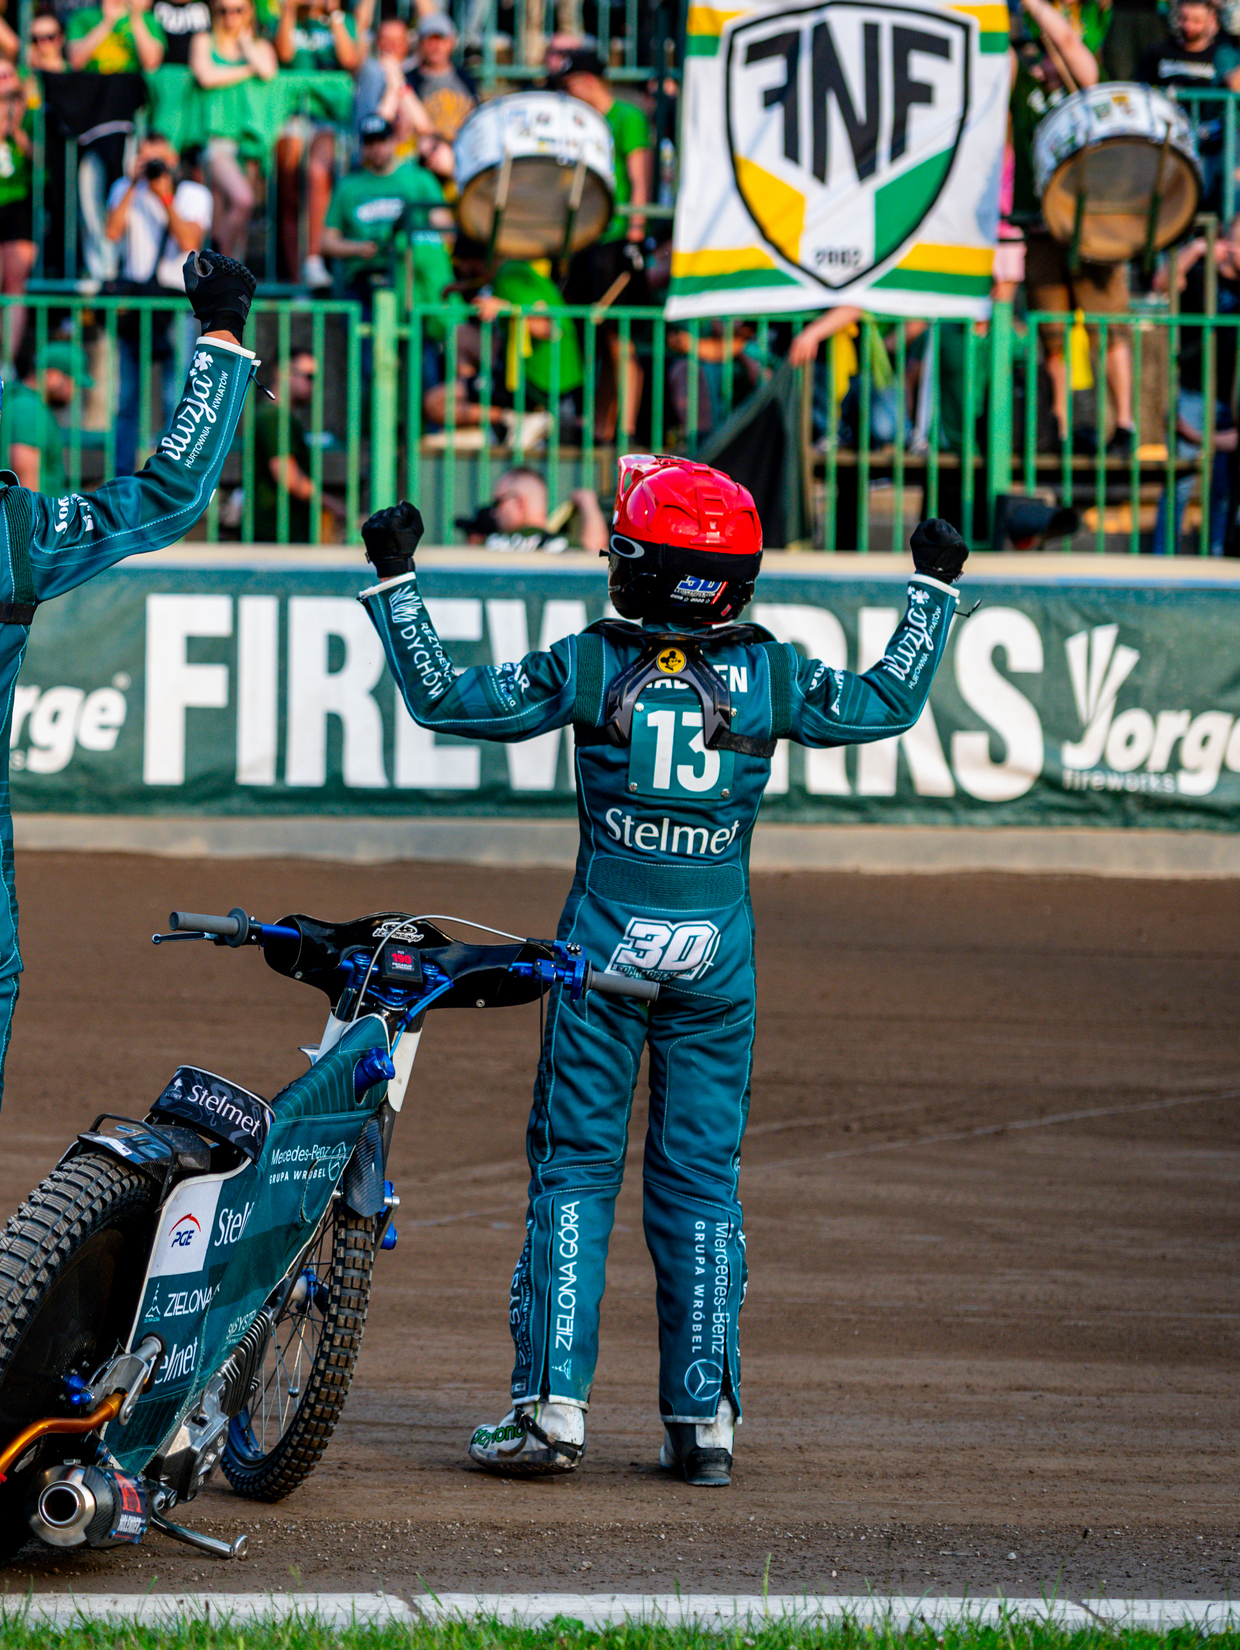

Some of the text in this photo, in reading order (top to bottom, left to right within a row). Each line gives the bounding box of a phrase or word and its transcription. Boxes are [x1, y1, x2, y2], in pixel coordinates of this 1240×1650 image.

[184, 370, 228, 468] HURTOWNIA KWIATÓW
[10, 684, 127, 774] rge
[142, 592, 1045, 803] FIREWRKS
[646, 709, 721, 793] 13
[1062, 690, 1240, 797] Jorg
[1063, 768, 1177, 794] fireworks
[605, 807, 740, 855] Stelmet
[391, 953, 412, 965] 190
[614, 920, 715, 971] 30
[187, 1084, 261, 1137] Stelmet
[269, 1171, 289, 1185] GRUPA
[171, 1229, 195, 1248] PGE
[555, 1201, 581, 1351] ZIELONA GÓRA
[691, 1220, 706, 1354] GRUPA WRÓBEL
[711, 1222, 735, 1355] Mercedes-Benz
